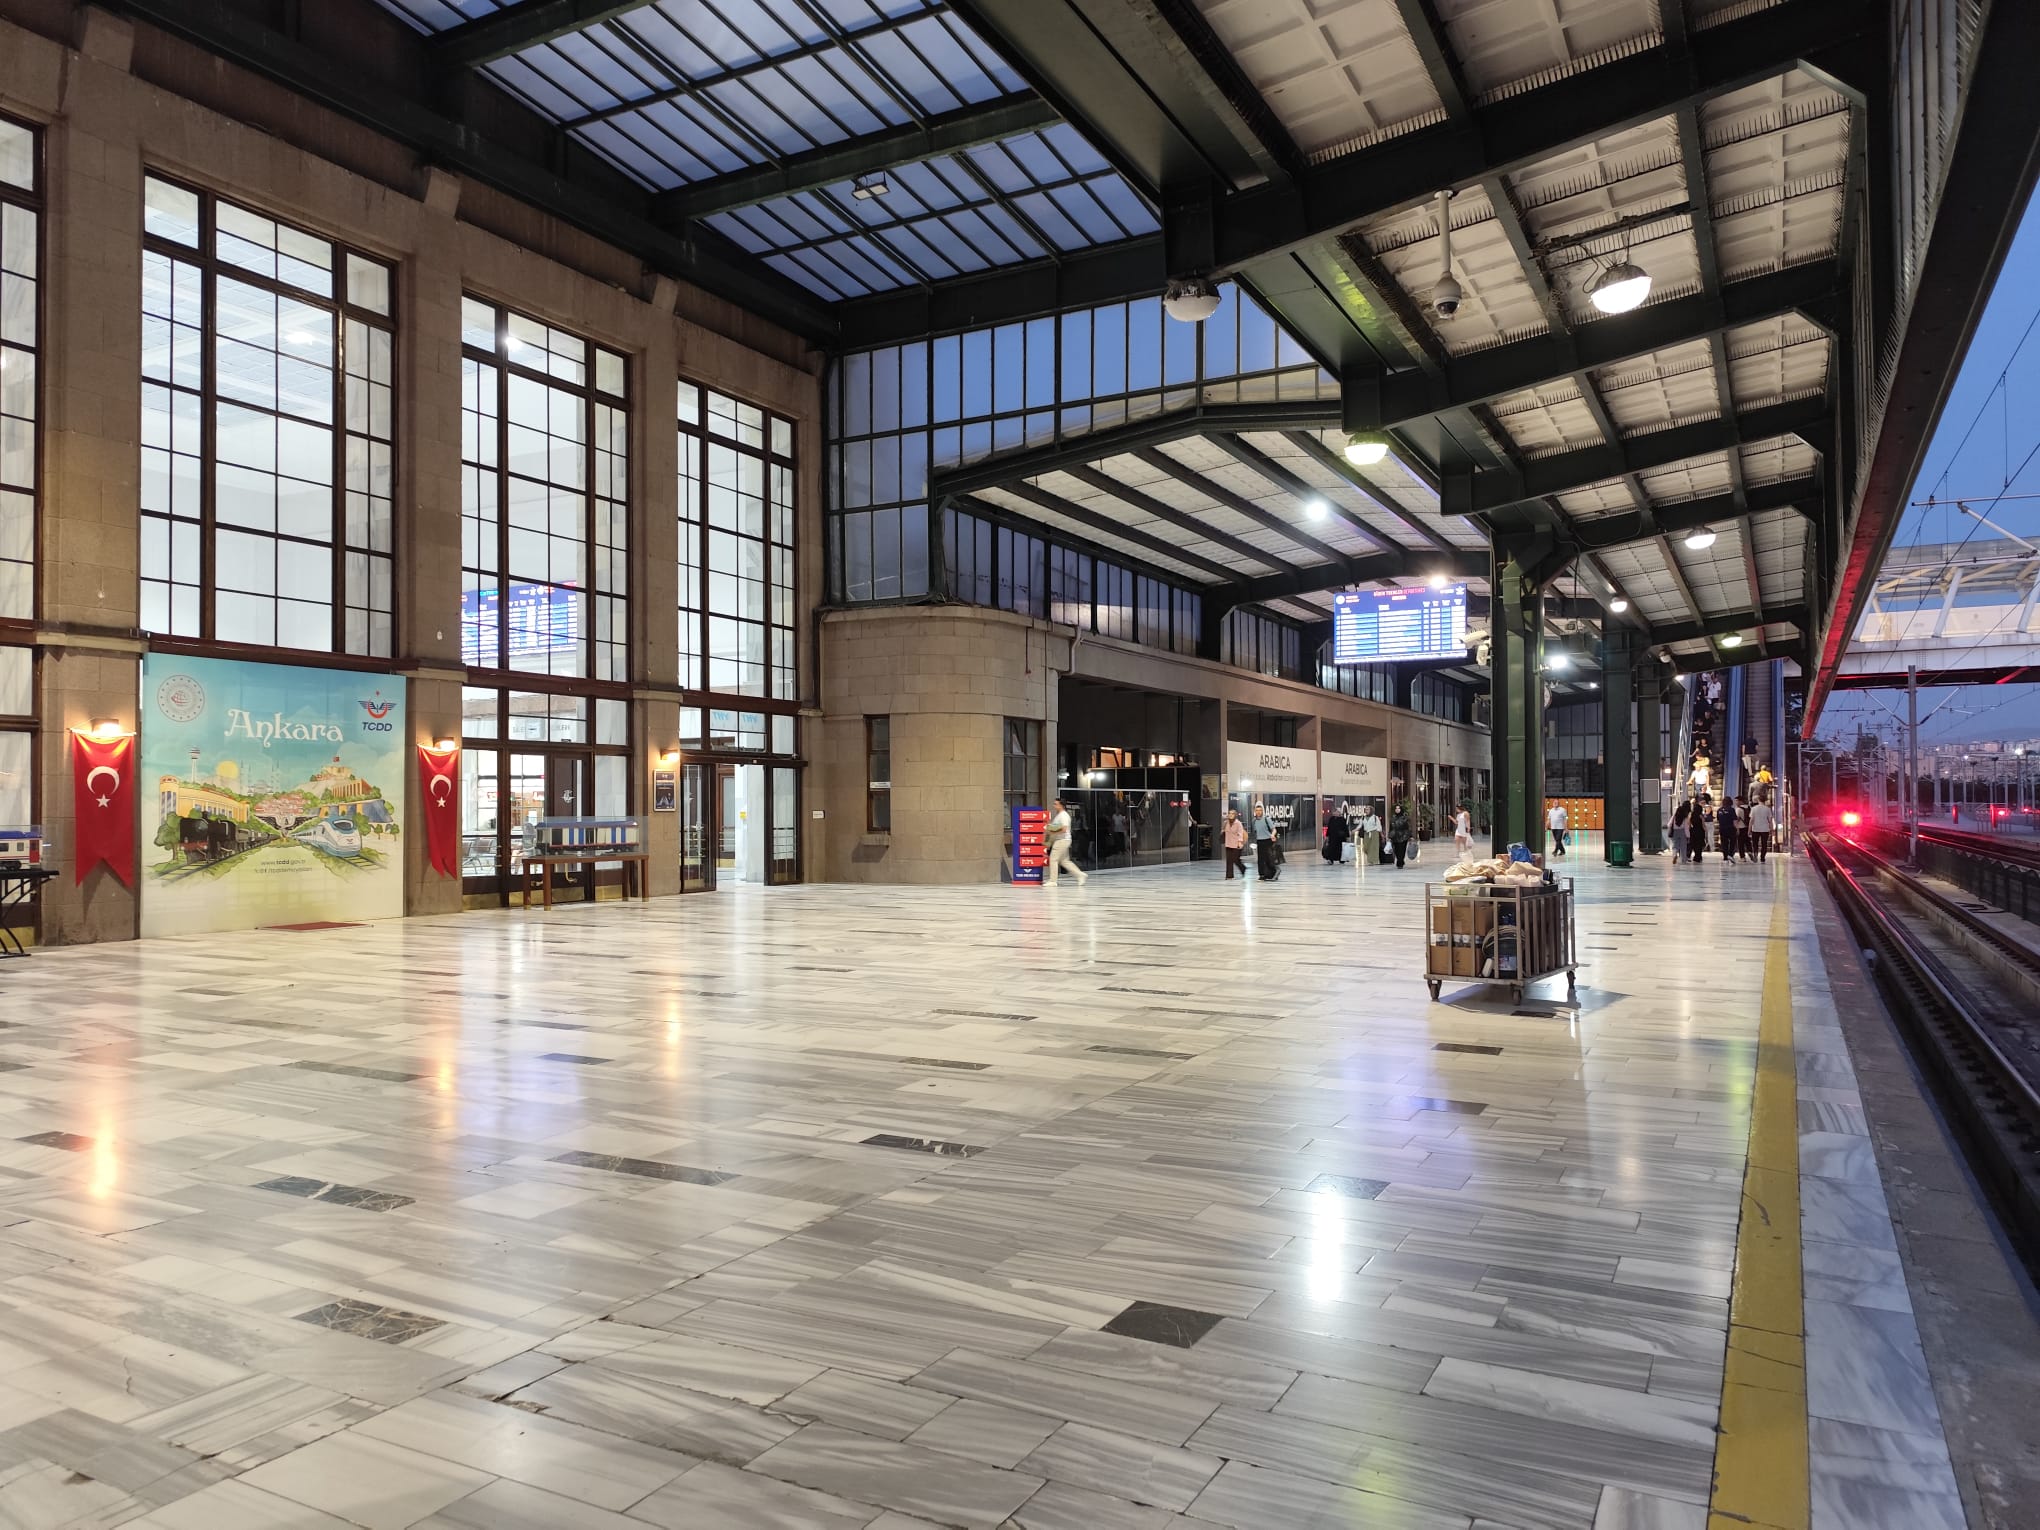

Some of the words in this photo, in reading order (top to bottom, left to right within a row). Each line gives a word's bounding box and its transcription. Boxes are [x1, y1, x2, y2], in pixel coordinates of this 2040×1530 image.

[224, 708, 344, 748] Ankara
[362, 721, 393, 732] TCDD
[1259, 754, 1292, 769] ARABICA
[1345, 762, 1368, 775] ARABICA
[1265, 805, 1295, 818] ARABICA
[1348, 804, 1367, 817] ARABIC
